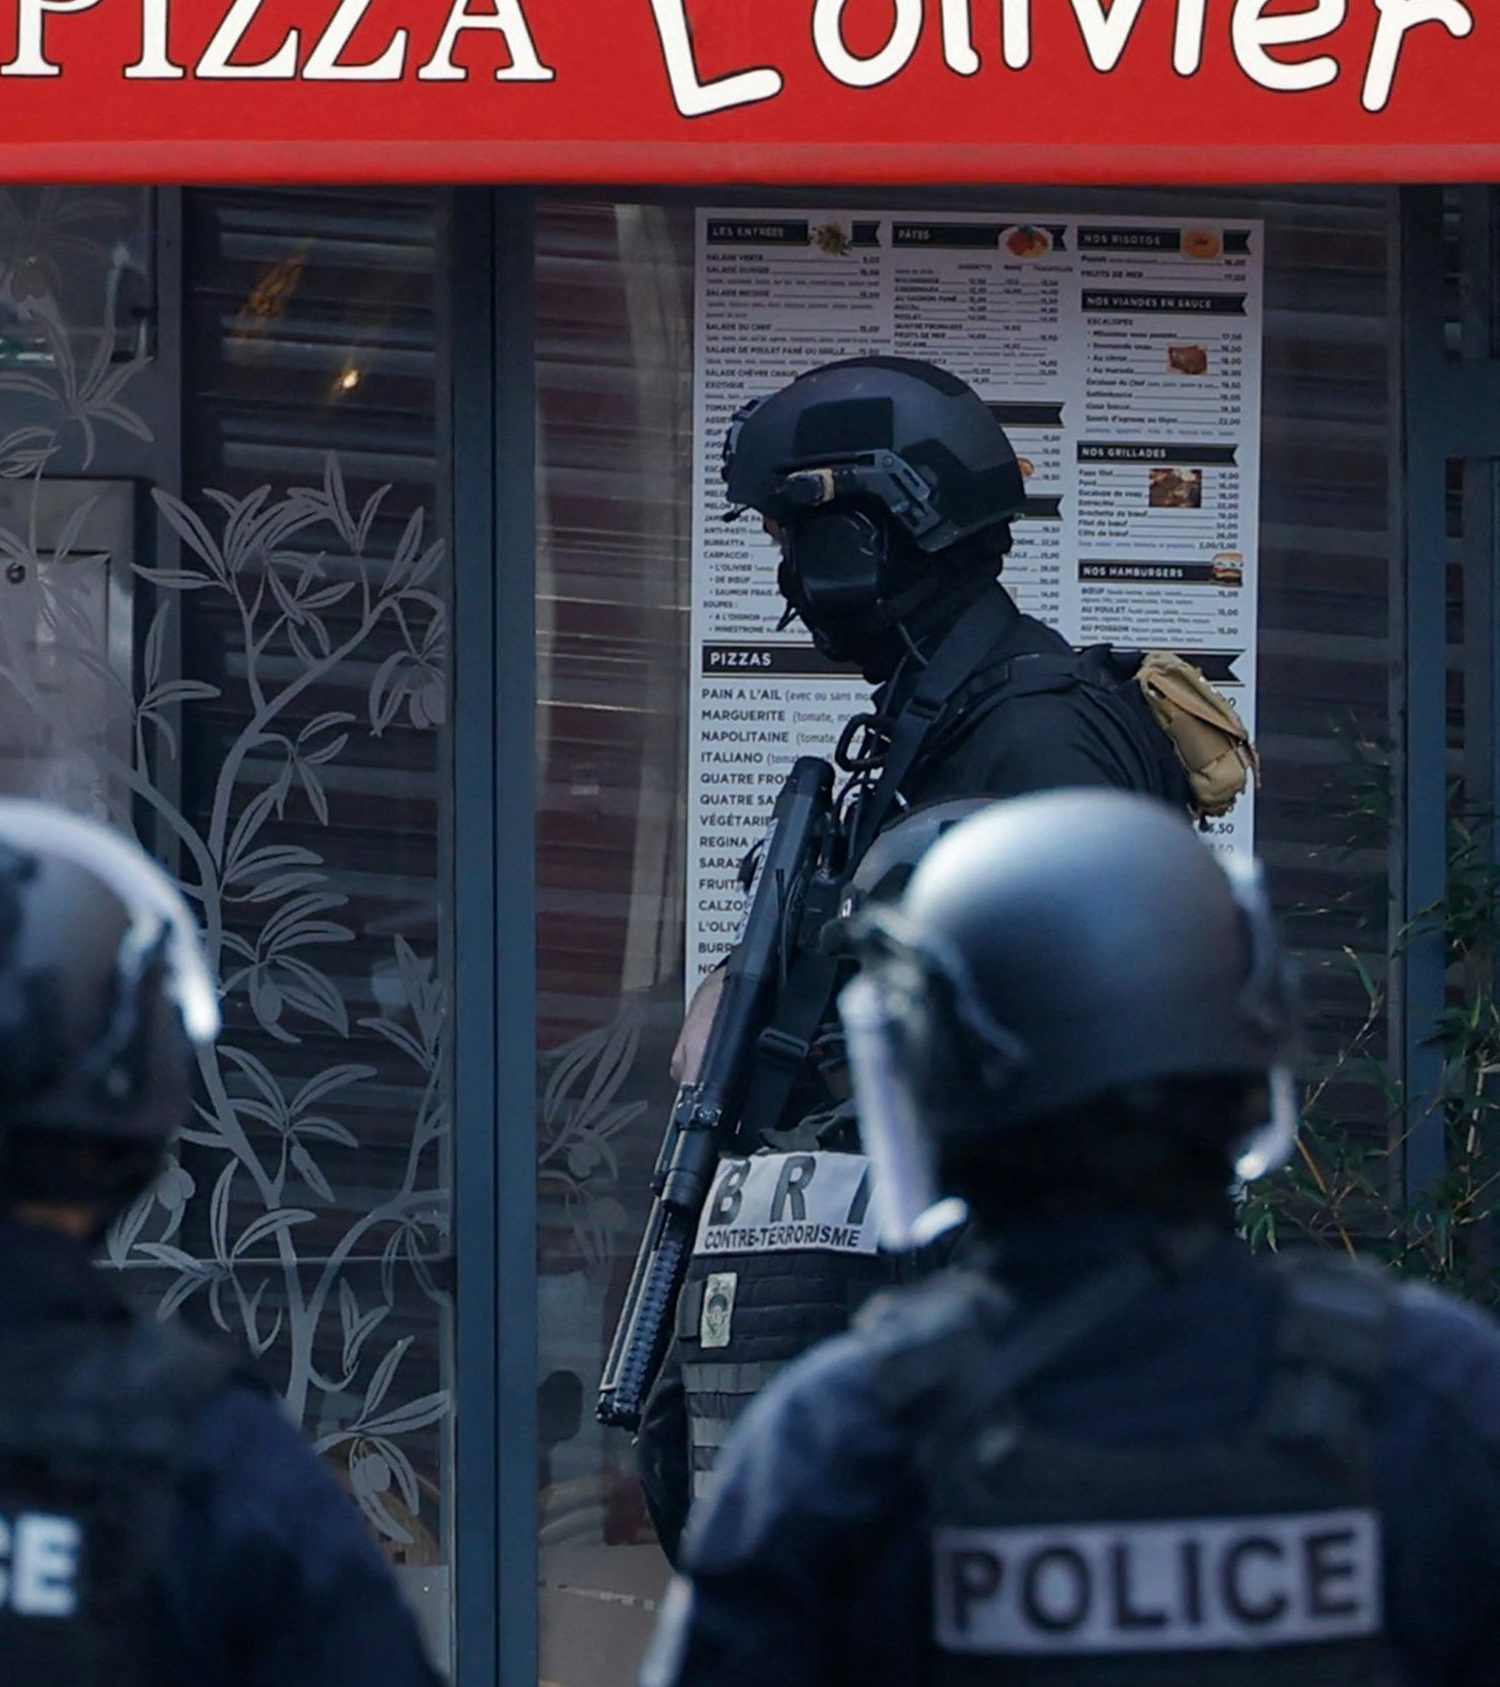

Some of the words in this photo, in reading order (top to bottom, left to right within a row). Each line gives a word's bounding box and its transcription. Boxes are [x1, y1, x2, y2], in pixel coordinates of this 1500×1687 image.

[0, 0, 557, 82] PIZZA
[1083, 234, 1108, 244] NOS
[1086, 296, 1109, 306] NOS
[1112, 297, 1158, 308] VIANDES
[1160, 298, 1175, 307] EN
[1177, 299, 1212, 309] SAUCE
[1081, 447, 1104, 457] NOS
[1107, 447, 1167, 458] GRILLADES
[1082, 566, 1106, 576] NOS
[1108, 567, 1184, 578] HAMBURGERS
[709, 652, 773, 667] PIZZAS
[701, 688, 733, 700] PAIN
[736, 689, 746, 700] A
[750, 689, 782, 701] L'AIL
[814, 692, 828, 701] ou
[830, 692, 851, 701] sans
[701, 709, 786, 722] MARGUERITE
[701, 731, 789, 743] NAPOLITAINE
[701, 752, 764, 764] ITALIANO
[701, 773, 754, 785] QUATRE
[700, 794, 754, 806] QUATRE
[699, 813, 772, 827] VÉGÉTARIE
[699, 837, 749, 848] REGINA
[699, 857, 743, 869] SARAZ
[699, 879, 737, 890] FRUIT
[698, 900, 743, 912] CALZO
[698, 921, 740, 933] L'OLIV
[698, 942, 733, 954] BURR
[704, 1224, 863, 1251] CONTRE-TERRORISME
[952, 1527, 1358, 1634] POLICE
